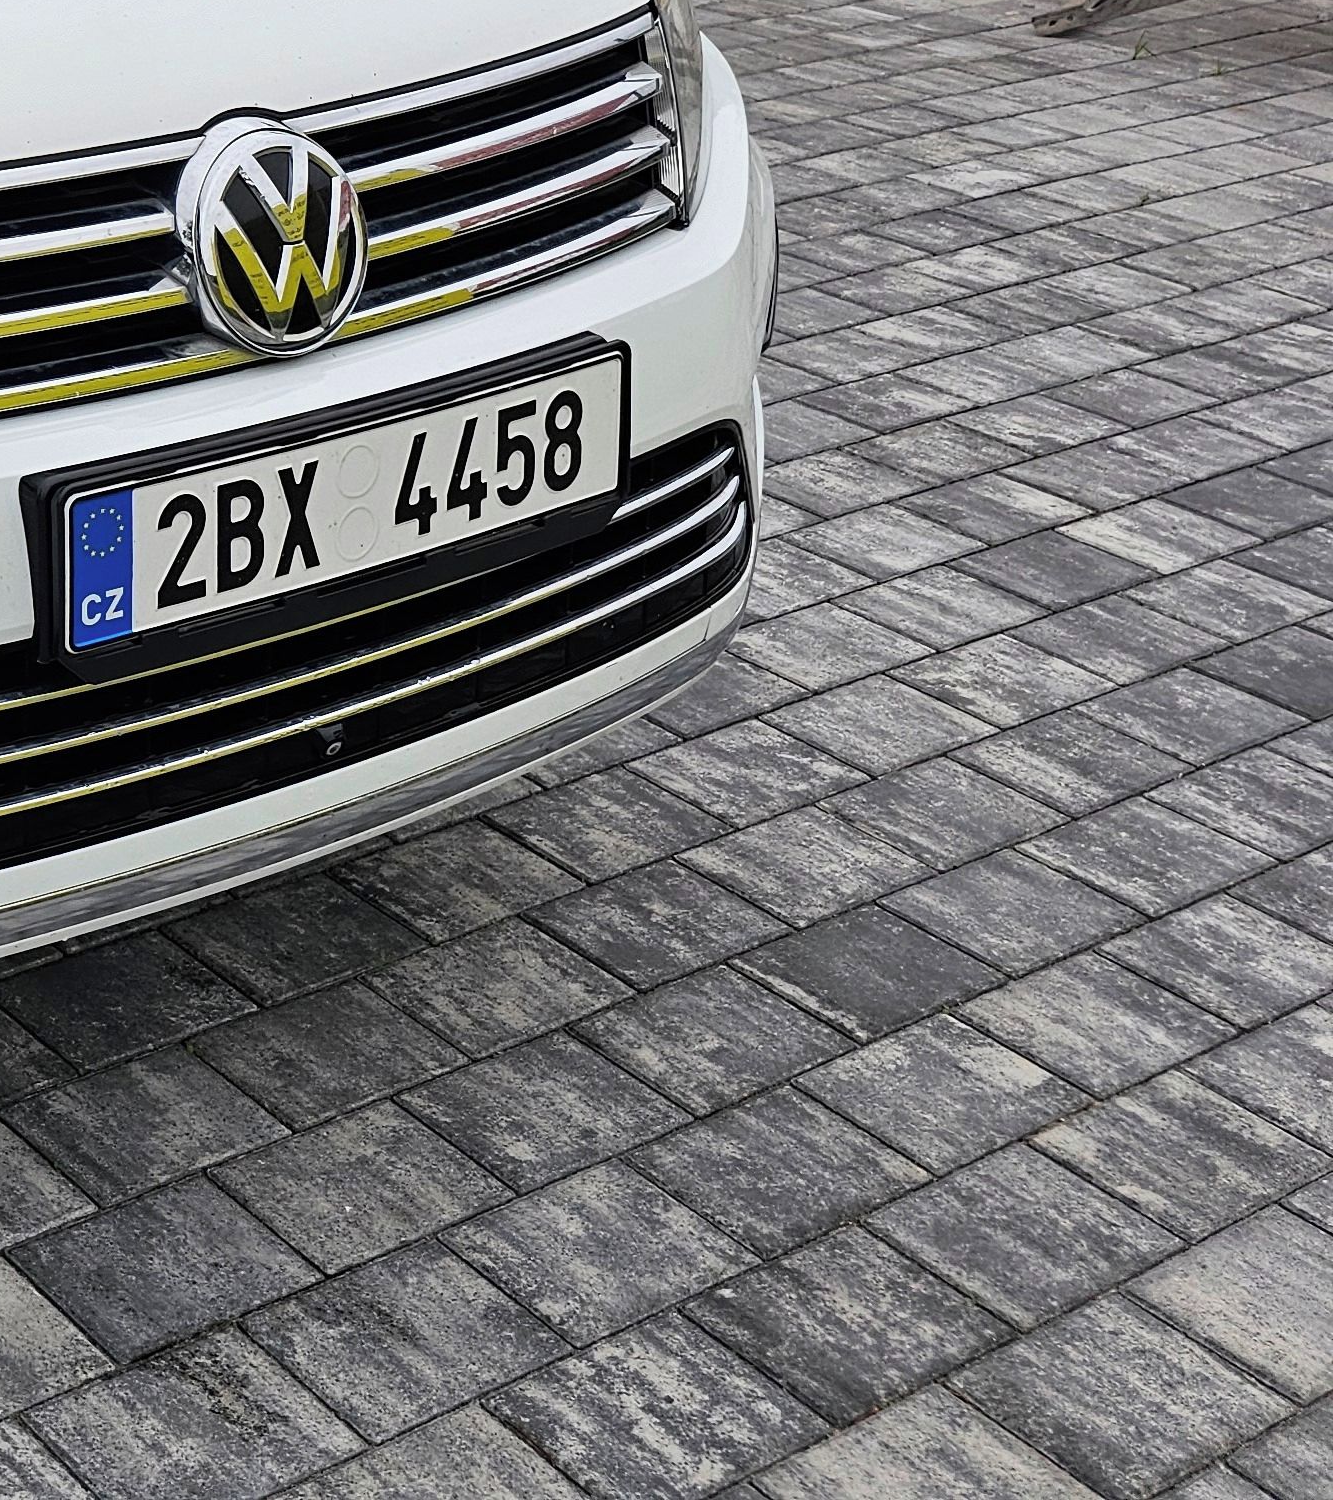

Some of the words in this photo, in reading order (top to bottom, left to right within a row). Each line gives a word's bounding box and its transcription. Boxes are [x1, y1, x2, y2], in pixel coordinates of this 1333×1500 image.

[156, 458, 322, 609] 2BX
[393, 389, 584, 536] 4458
[80, 587, 126, 627] CZ
